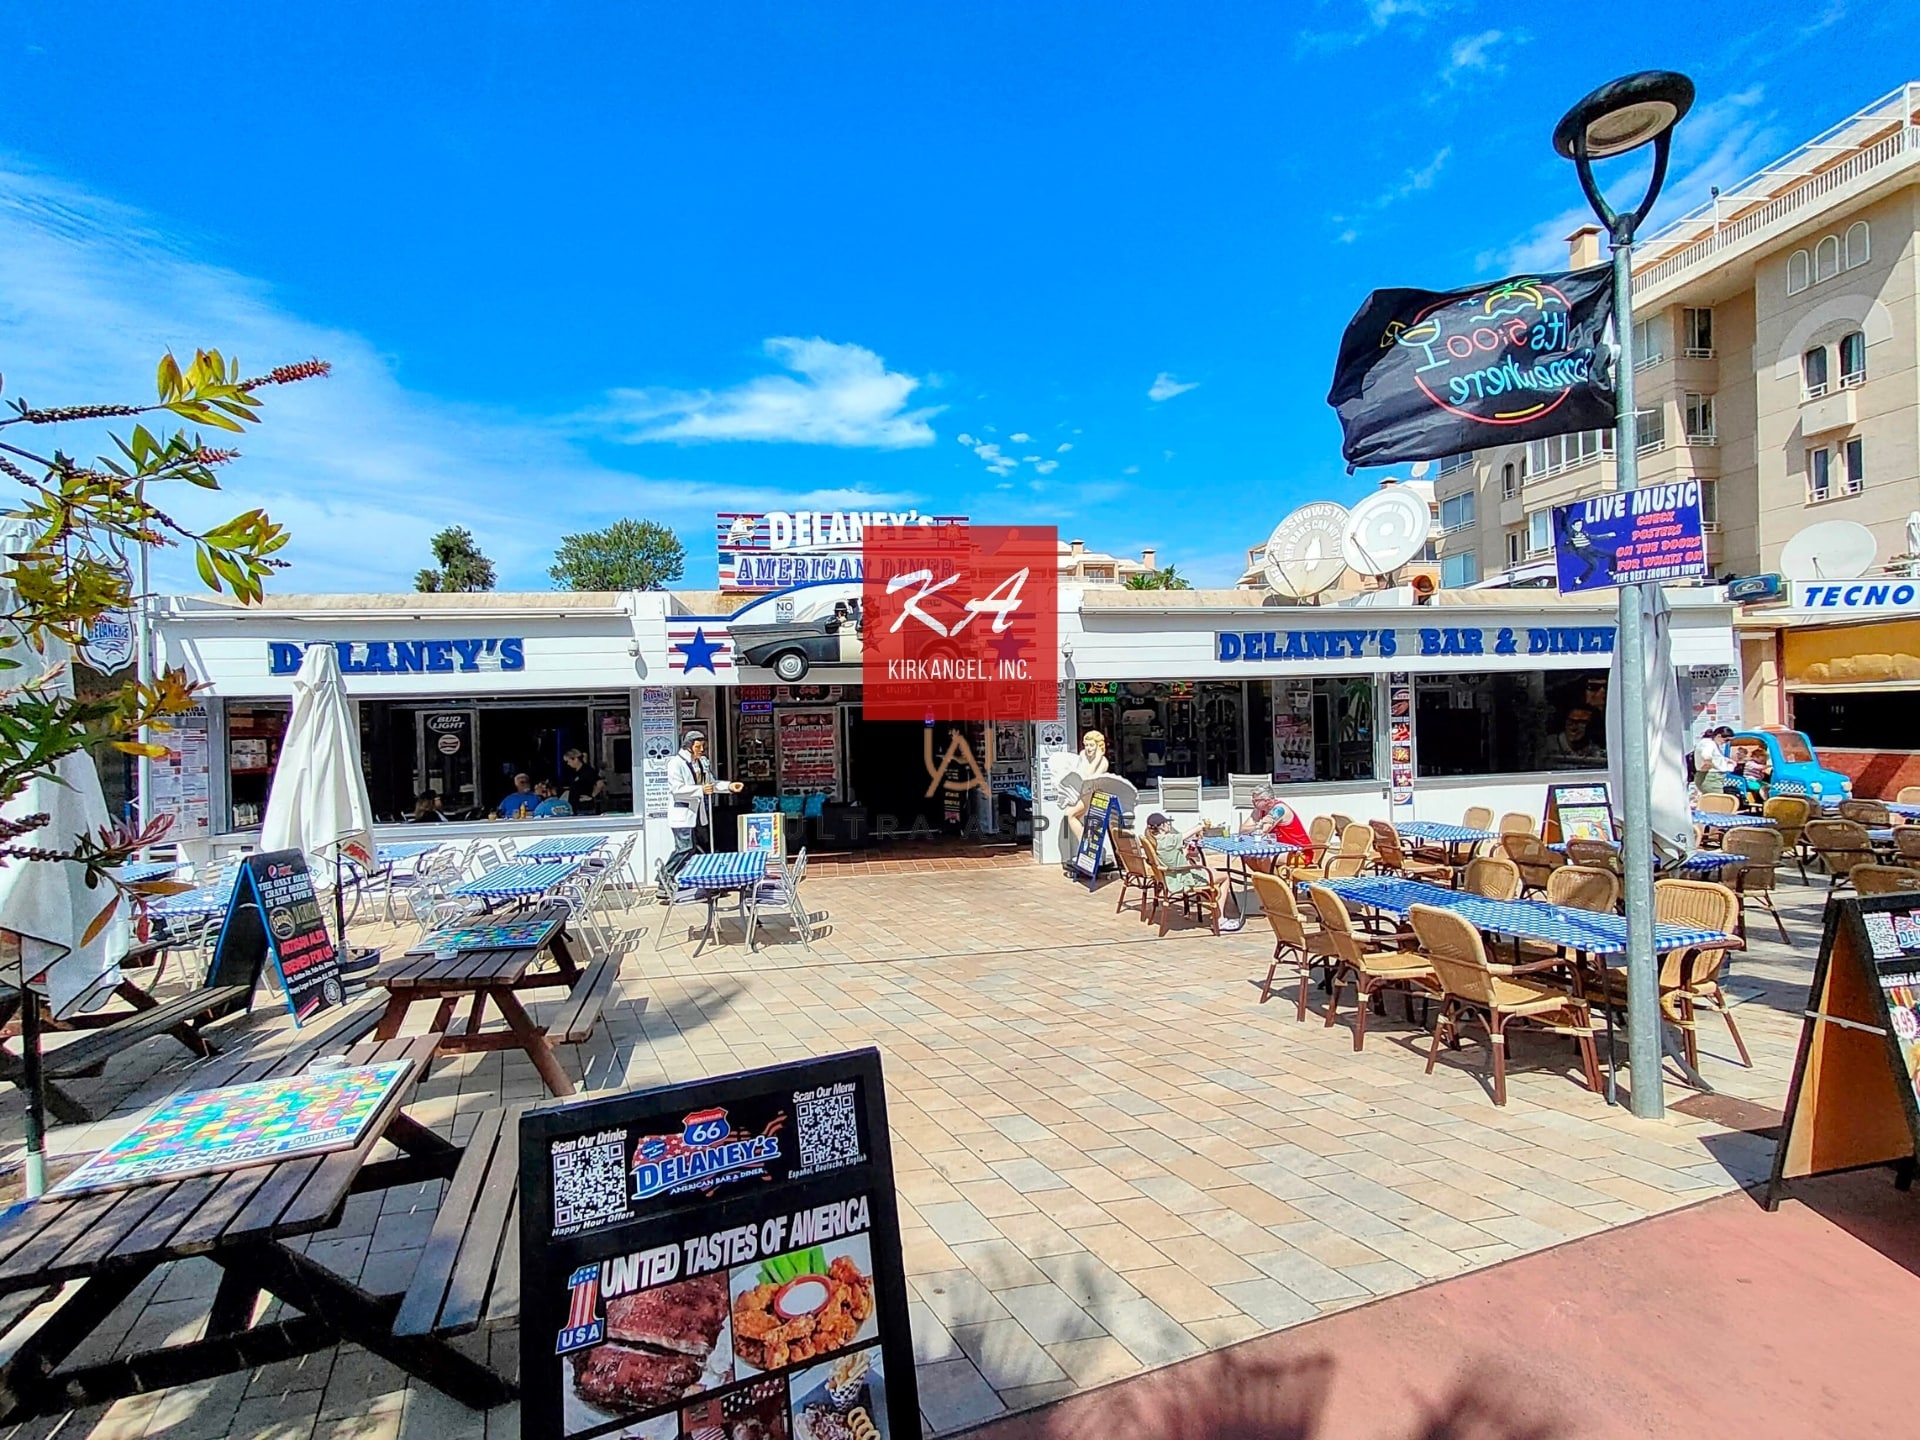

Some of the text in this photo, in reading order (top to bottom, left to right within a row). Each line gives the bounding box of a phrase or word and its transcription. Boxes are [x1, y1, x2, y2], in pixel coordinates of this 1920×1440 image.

[1585, 482, 1697, 524] LIVE MUSIC
[1637, 511, 1676, 526] CHECK
[764, 510, 935, 550] DELANEY'S
[1632, 524, 1683, 541] POSTERS
[1616, 536, 1701, 557] ON THE DOORS
[737, 557, 873, 585] AMERICAN
[1617, 551, 1702, 571] FOR WHATS ON
[1630, 570, 1647, 582] BEST
[1671, 566, 1680, 575] IN
[1804, 585, 1915, 607] TECNO
[776, 602, 793, 611] NO
[1219, 629, 1397, 661] DELANEY'S
[1419, 628, 1483, 654] BAR
[1495, 627, 1518, 653] &
[432, 721, 466, 730] LIGHT
[437, 715, 461, 723] BUD
[744, 715, 770, 723] DINER
[258, 881, 273, 891] THE
[274, 876, 292, 887] ONLY
[265, 886, 288, 898] CRAFT
[292, 888, 312, 900] TOWN
[793, 1082, 856, 1103] Scan Our Menu
[551, 1128, 627, 1154] Scan Our Drinks
[692, 1122, 720, 1142] 66
[631, 1136, 779, 1193] DELANEY'S
[845, 1152, 868, 1165] English
[670, 1179, 714, 1195] AMERICAN
[715, 1174, 732, 1185] BAR
[740, 1167, 765, 1178] DINER
[552, 1211, 635, 1237] Happy Hour Offers
[601, 1195, 872, 1298] UNITED TASTES OF AMERICA
[561, 1326, 600, 1347] USA
